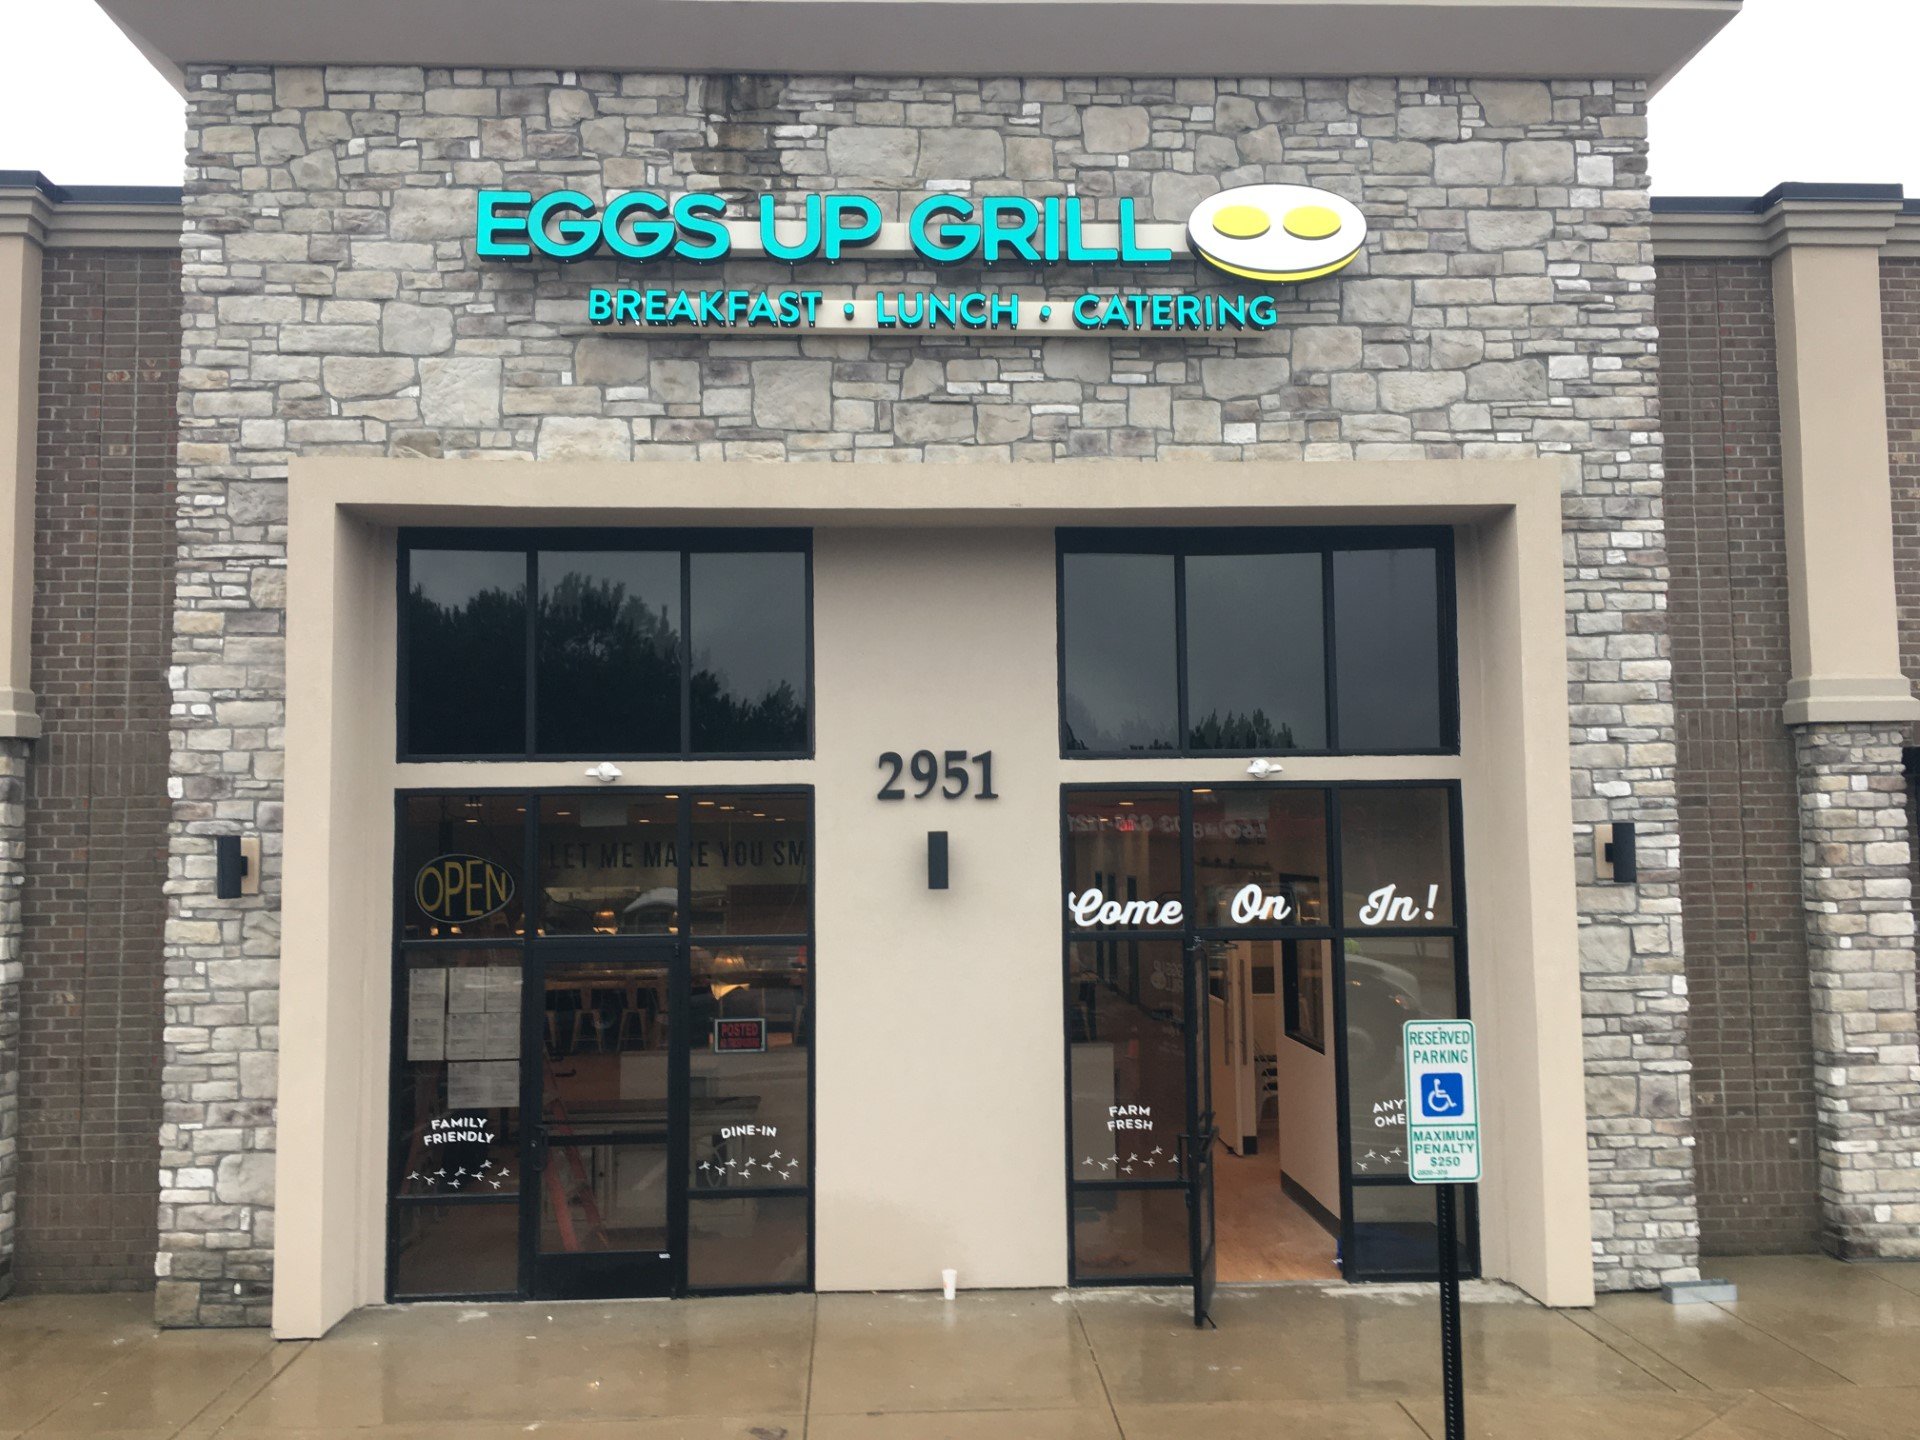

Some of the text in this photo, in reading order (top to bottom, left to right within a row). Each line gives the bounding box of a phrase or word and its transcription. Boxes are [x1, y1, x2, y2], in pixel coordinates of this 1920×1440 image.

[475, 189, 1173, 264] EGGS UP GRILL
[587, 288, 1279, 330] BREAKFAST LUNCH CATERING
[876, 749, 999, 801] 2951
[550, 842, 590, 869] LET
[600, 842, 633, 868] ME
[644, 841, 709, 867] MAE
[719, 841, 763, 866] YOU
[418, 860, 507, 917] OPEN
[1068, 887, 1184, 927] Come
[1230, 883, 1292, 924] On
[1409, 1030, 1470, 1045] RESERVED
[1413, 1049, 1468, 1064] PARKING
[1108, 1104, 1151, 1117] FARM
[1372, 1098, 1407, 1114] ANY
[430, 1117, 488, 1131] FAMILY
[720, 1124, 777, 1139] DINE-IN
[1106, 1118, 1153, 1132] FRESH
[423, 1130, 495, 1146] FRIENDLY
[1413, 1130, 1475, 1142] MAXIMUM
[1415, 1143, 1474, 1154] PENALTY
[1430, 1156, 1460, 1167] $250
